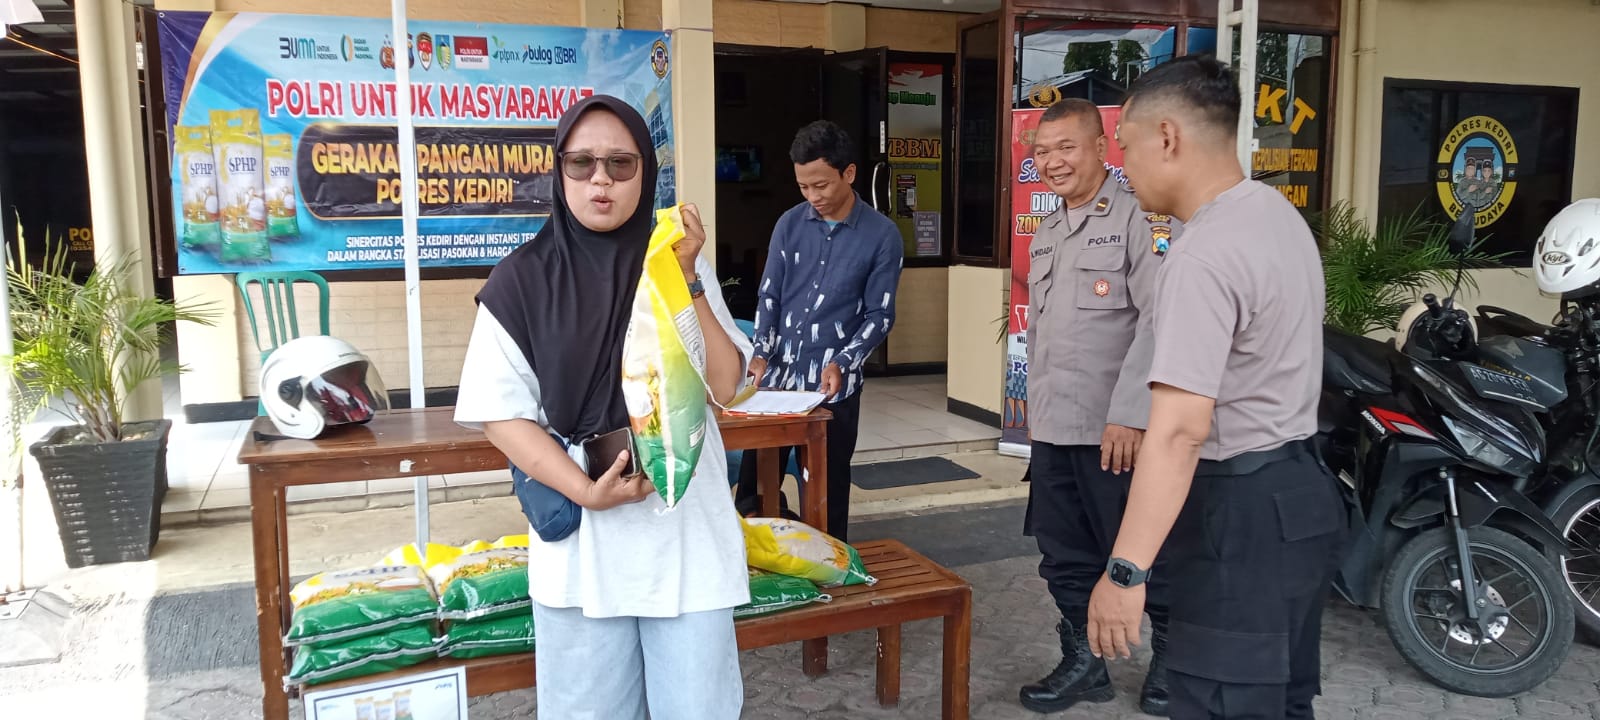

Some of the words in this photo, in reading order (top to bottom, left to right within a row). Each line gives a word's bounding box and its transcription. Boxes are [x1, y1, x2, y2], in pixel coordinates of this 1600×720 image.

[528, 45, 553, 64] bulog
[563, 47, 576, 63] BRI
[267, 80, 343, 117] POLRI
[1444, 119, 1481, 153] POLRES
[1484, 120, 1514, 155] KEDIRI
[888, 137, 940, 159] BBM
[228, 156, 257, 173] SPHP
[311, 143, 400, 174] GERAKA
[417, 143, 498, 173] PANGAN
[190, 162, 213, 176] SPHP
[270, 166, 290, 177] SPHP
[376, 178, 449, 204] PORES
[453, 178, 513, 203] KEDIRI
[1448, 203, 1505, 225] BEUDAYA
[346, 236, 393, 248] SINERGITAS
[394, 235, 425, 247] POES
[426, 235, 451, 246] KEDIRI
[453, 234, 484, 245] DENGAN
[486, 233, 520, 245] INSTANSI
[1088, 234, 1121, 246] POLRI
[327, 250, 357, 262] DALAM
[358, 249, 392, 261] RANGKA
[441, 247, 478, 259] PASOKAN
[479, 248, 485, 257] &
[486, 246, 512, 258] HARGA
[1360, 409, 1386, 435] HONDA
